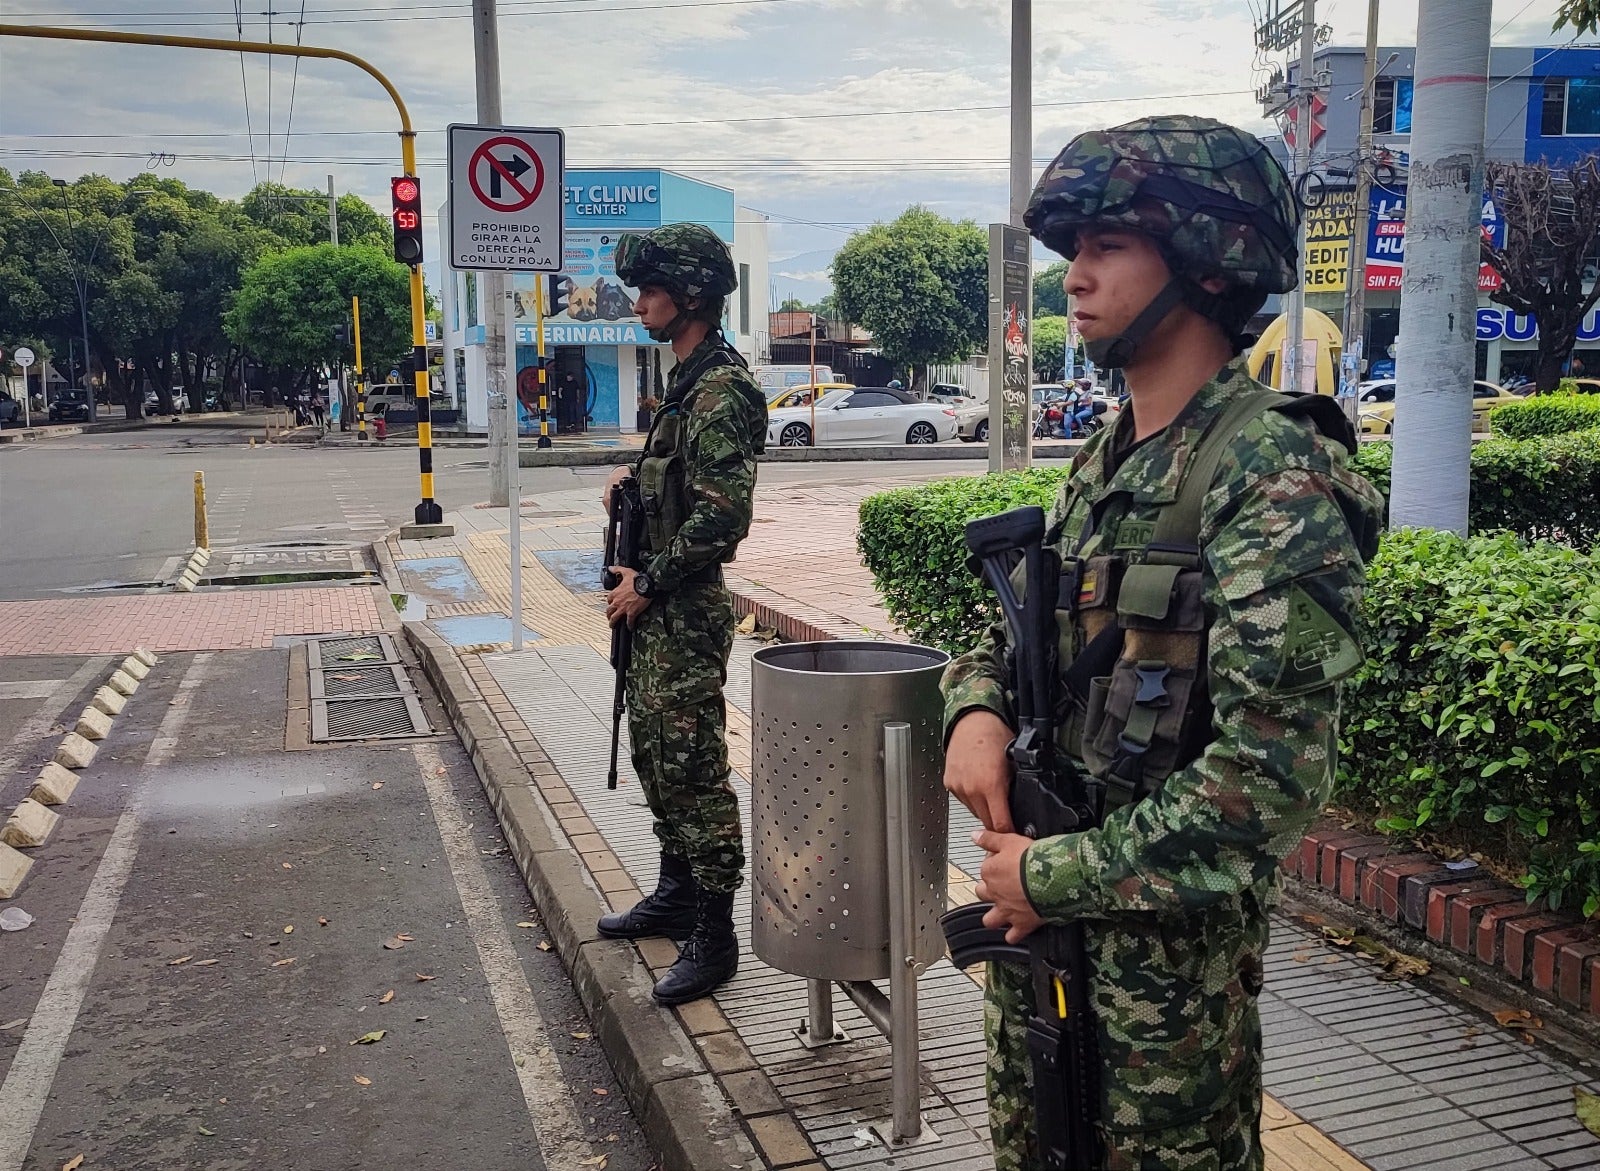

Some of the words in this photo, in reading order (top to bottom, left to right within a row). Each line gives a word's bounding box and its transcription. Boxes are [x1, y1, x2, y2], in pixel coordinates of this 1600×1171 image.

[588, 185, 657, 203] CLINIC
[576, 204, 627, 215] CENTER
[398, 212, 416, 228] 53
[472, 223, 540, 233] PROHIBIDO
[471, 234, 509, 243] GIRAR
[525, 236, 541, 244] LA
[477, 245, 535, 254] DERECHA
[460, 255, 486, 263] CON
[490, 256, 515, 264] LUZ
[518, 257, 552, 265] ROJA
[1368, 276, 1386, 287] SIN
[515, 327, 637, 342] ETERINARIA
[245, 550, 350, 565] PARE
[1297, 602, 1312, 621] 5
